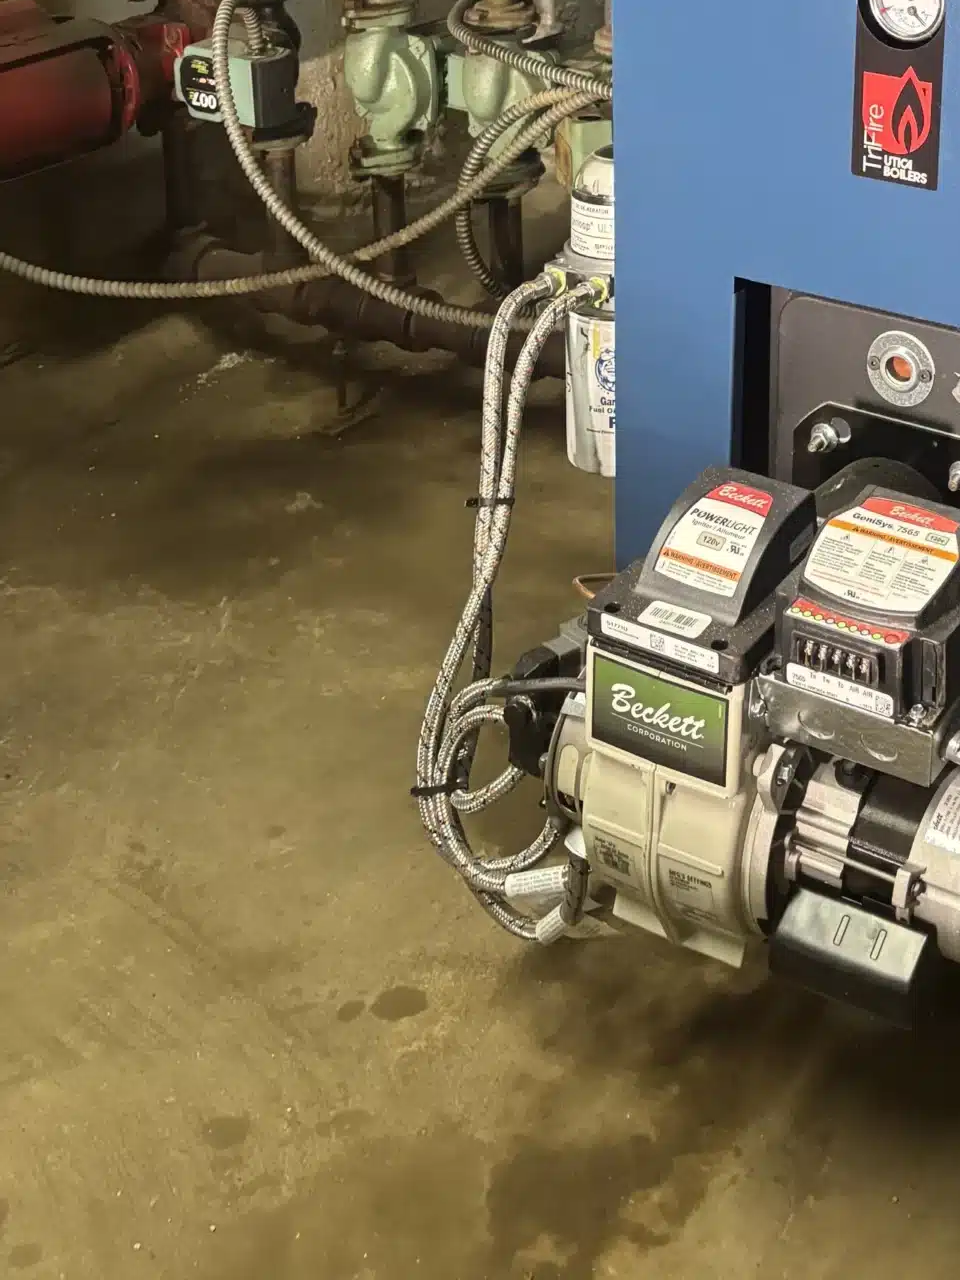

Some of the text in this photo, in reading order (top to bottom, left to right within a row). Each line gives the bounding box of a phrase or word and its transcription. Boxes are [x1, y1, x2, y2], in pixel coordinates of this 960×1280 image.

[862, 104, 885, 173] TriFire
[883, 154, 913, 171] UTICA
[883, 165, 928, 185] BOILERS
[719, 485, 769, 509] Beckett
[690, 507, 757, 535] POWERLIGHT
[611, 683, 706, 740] Beckett
[627, 723, 688, 752] CORPORATION
